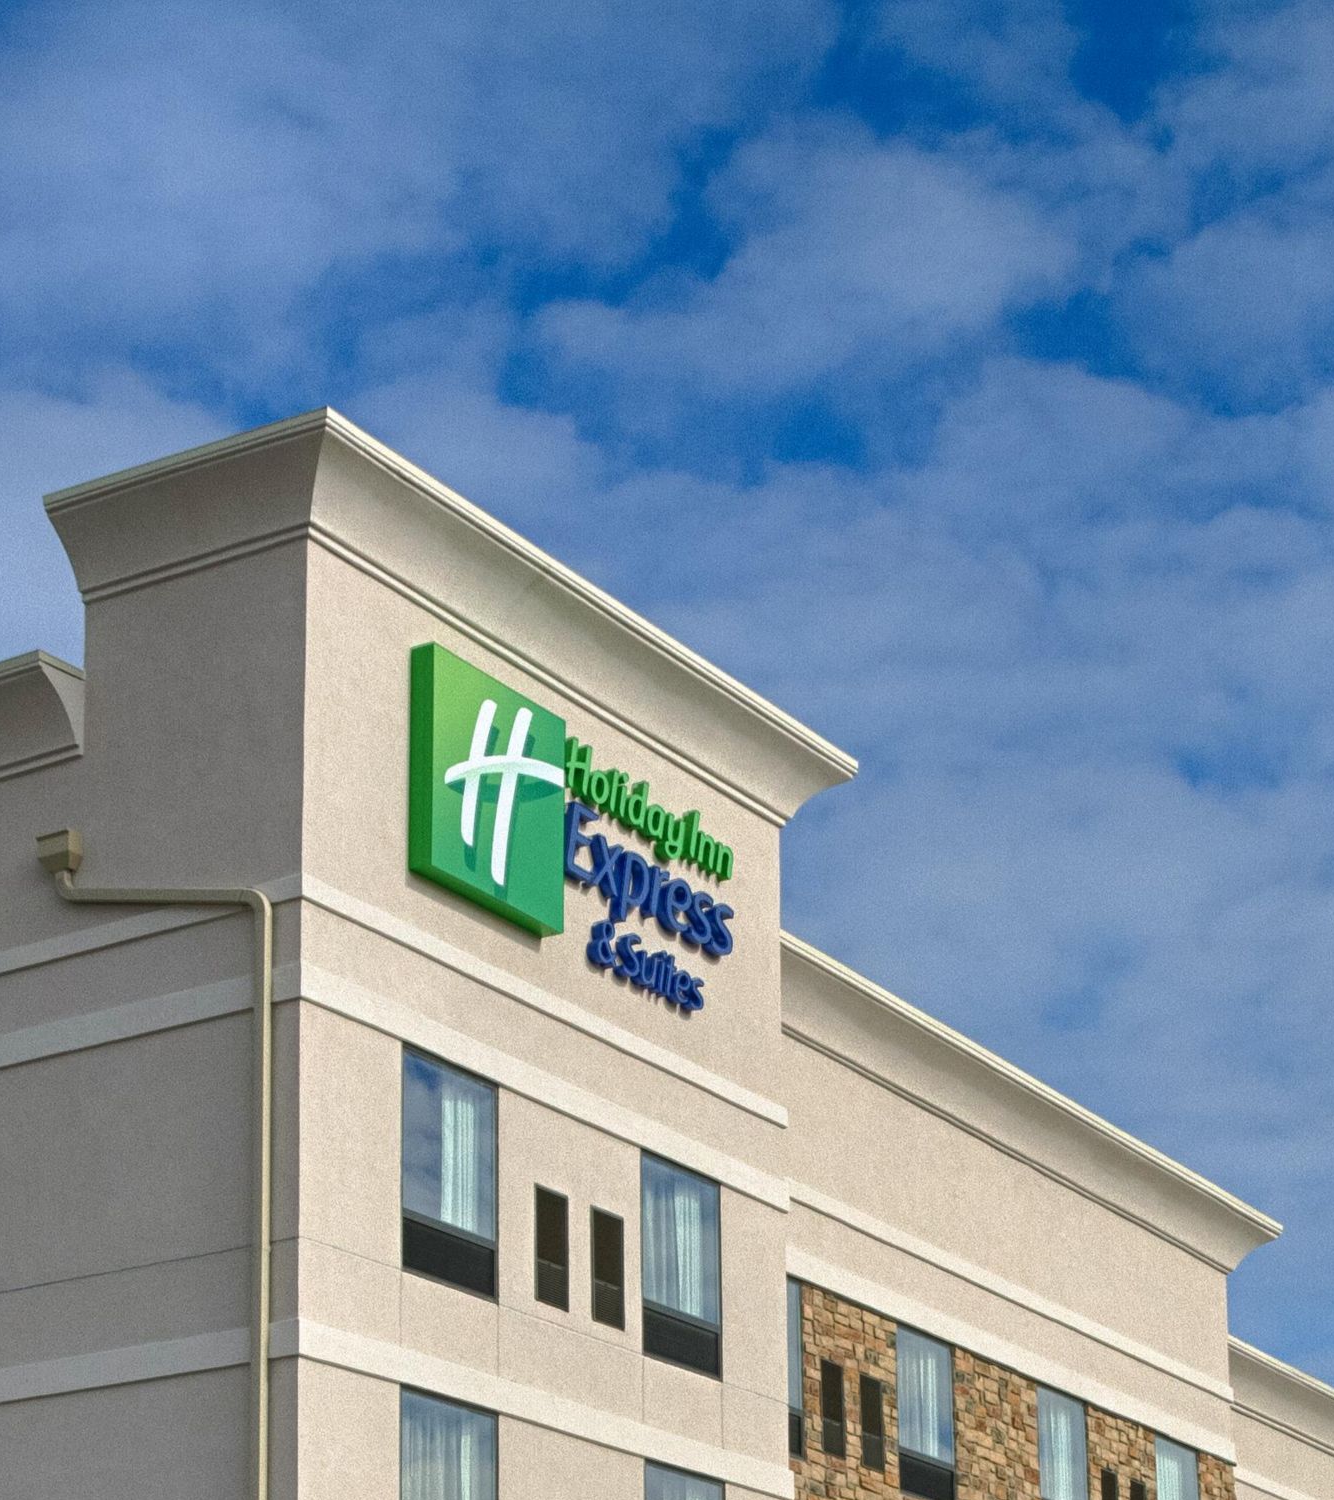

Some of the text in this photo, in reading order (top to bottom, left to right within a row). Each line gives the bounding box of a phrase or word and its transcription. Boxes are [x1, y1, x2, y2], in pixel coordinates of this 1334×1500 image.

[565, 736, 734, 882] Holiday Inn
[565, 800, 735, 957] Express
